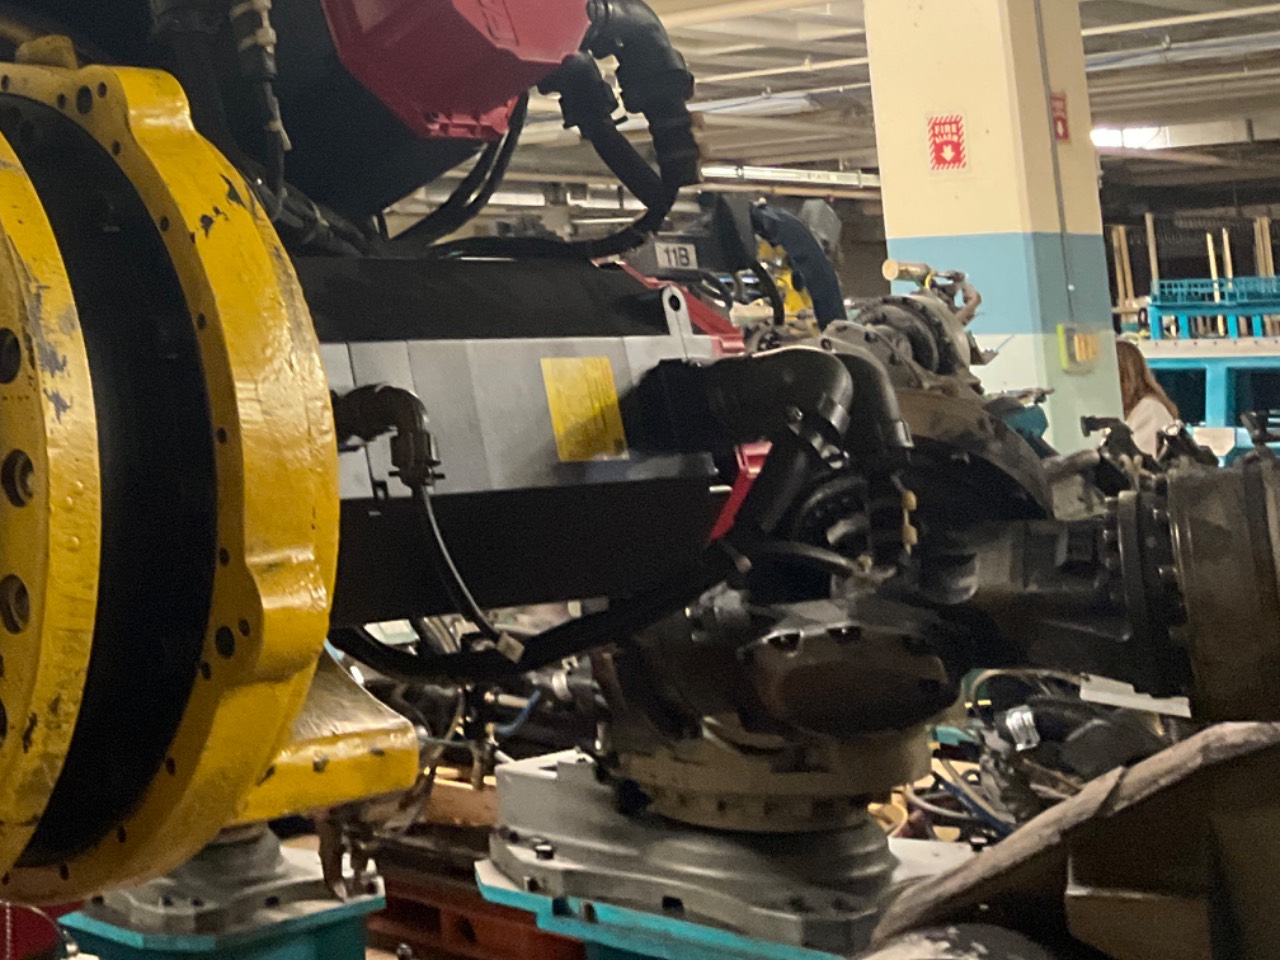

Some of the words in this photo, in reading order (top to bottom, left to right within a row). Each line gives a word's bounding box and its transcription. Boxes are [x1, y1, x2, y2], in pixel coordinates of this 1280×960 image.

[934, 123, 958, 135] FIRE
[934, 134, 959, 145] ALARM
[664, 246, 690, 267] 11B
